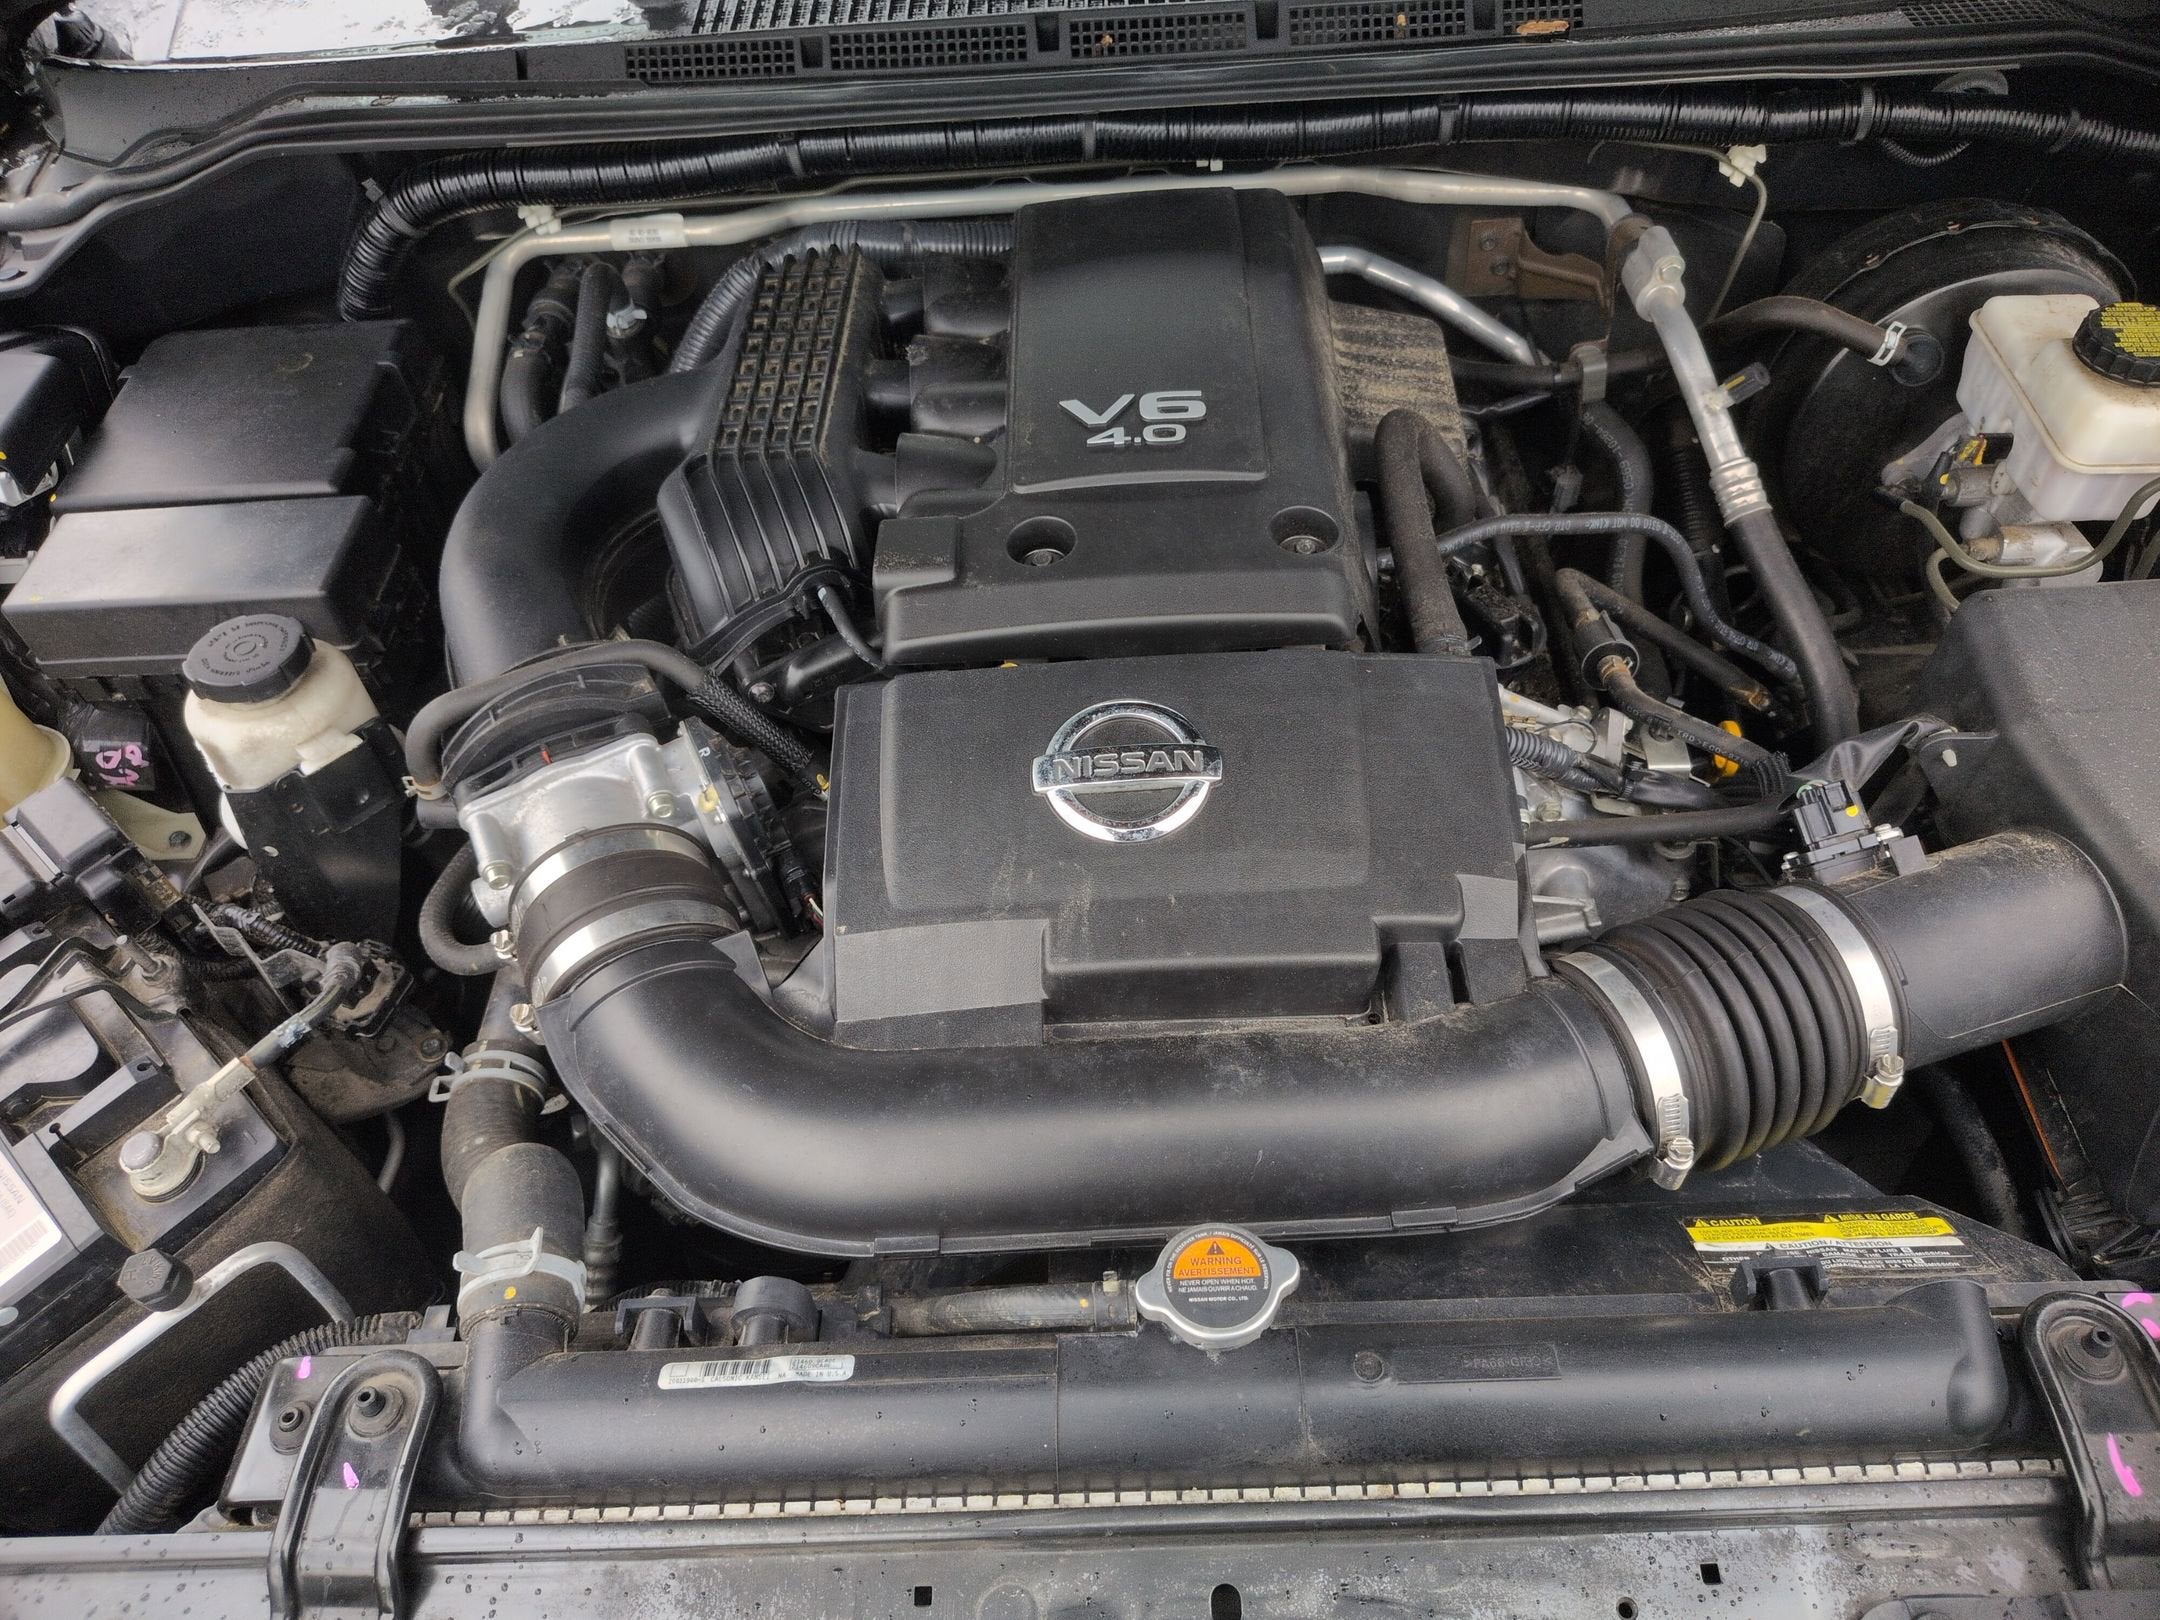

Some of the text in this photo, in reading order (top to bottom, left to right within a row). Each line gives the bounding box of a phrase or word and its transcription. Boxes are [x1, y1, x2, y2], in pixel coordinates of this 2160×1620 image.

[1058, 390, 1207, 429] V6
[1086, 423, 1187, 447] 4.0
[1053, 750, 1204, 780] NISSAN
[1838, 1211, 1920, 1222] MISE EN GARDE
[1710, 1217, 1762, 1227] CAUTION
[1779, 1240, 1828, 1249] CAUTION
[1835, 1239, 1894, 1248] ATTENTION
[1190, 1257, 1242, 1266] WARNING
[1178, 1267, 1256, 1277] AVERTISSEMENT
[1179, 1279, 1201, 1287] NEVER
